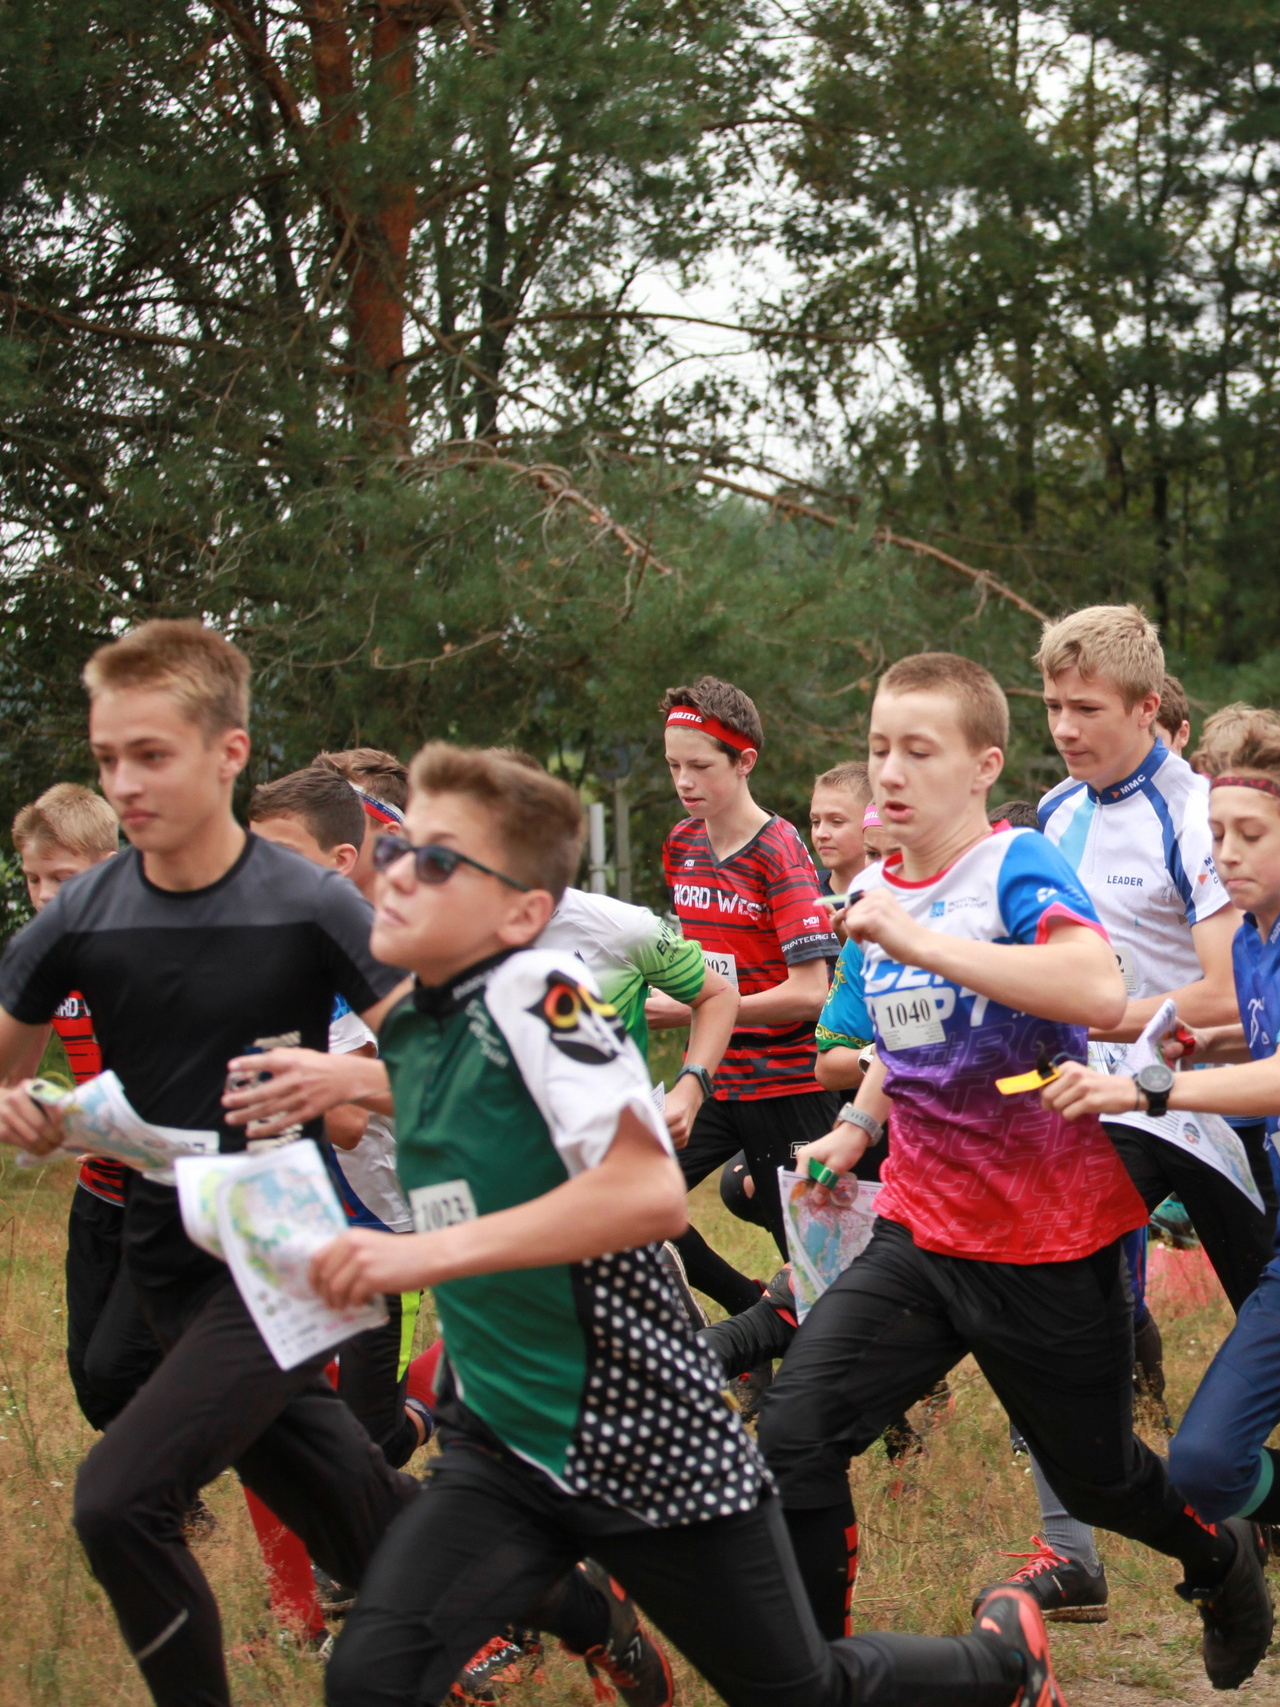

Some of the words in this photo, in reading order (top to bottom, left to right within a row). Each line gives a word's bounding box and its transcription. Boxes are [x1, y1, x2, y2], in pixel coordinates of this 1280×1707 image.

[1120, 774, 1146, 794] MMC
[1107, 875, 1144, 887] LEADER
[674, 884, 711, 910] NORD
[885, 998, 931, 1028] 1040
